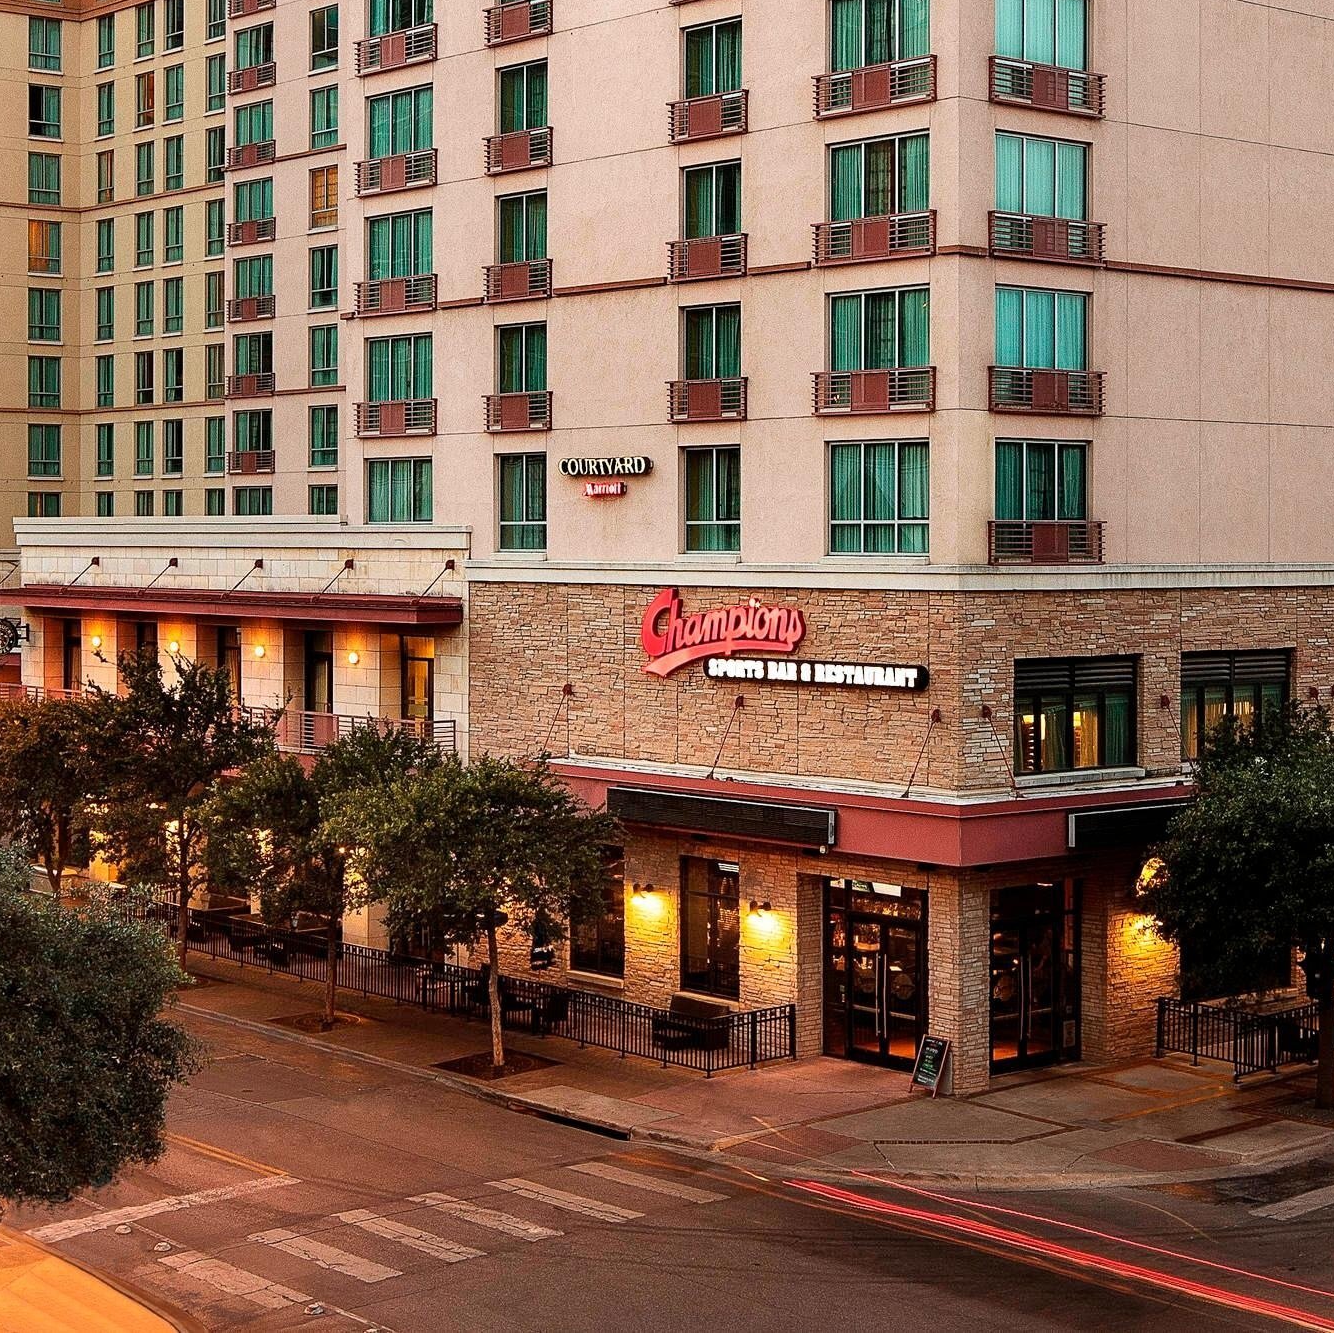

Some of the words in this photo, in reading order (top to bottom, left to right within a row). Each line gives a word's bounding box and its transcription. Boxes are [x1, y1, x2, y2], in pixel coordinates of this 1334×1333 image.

[558, 456, 646, 476] COURTYARD
[641, 588, 805, 657] Champions
[708, 658, 764, 679] SPORTS
[767, 661, 797, 681] BAR
[800, 663, 811, 682] &
[814, 664, 918, 688] RESTAURANT
